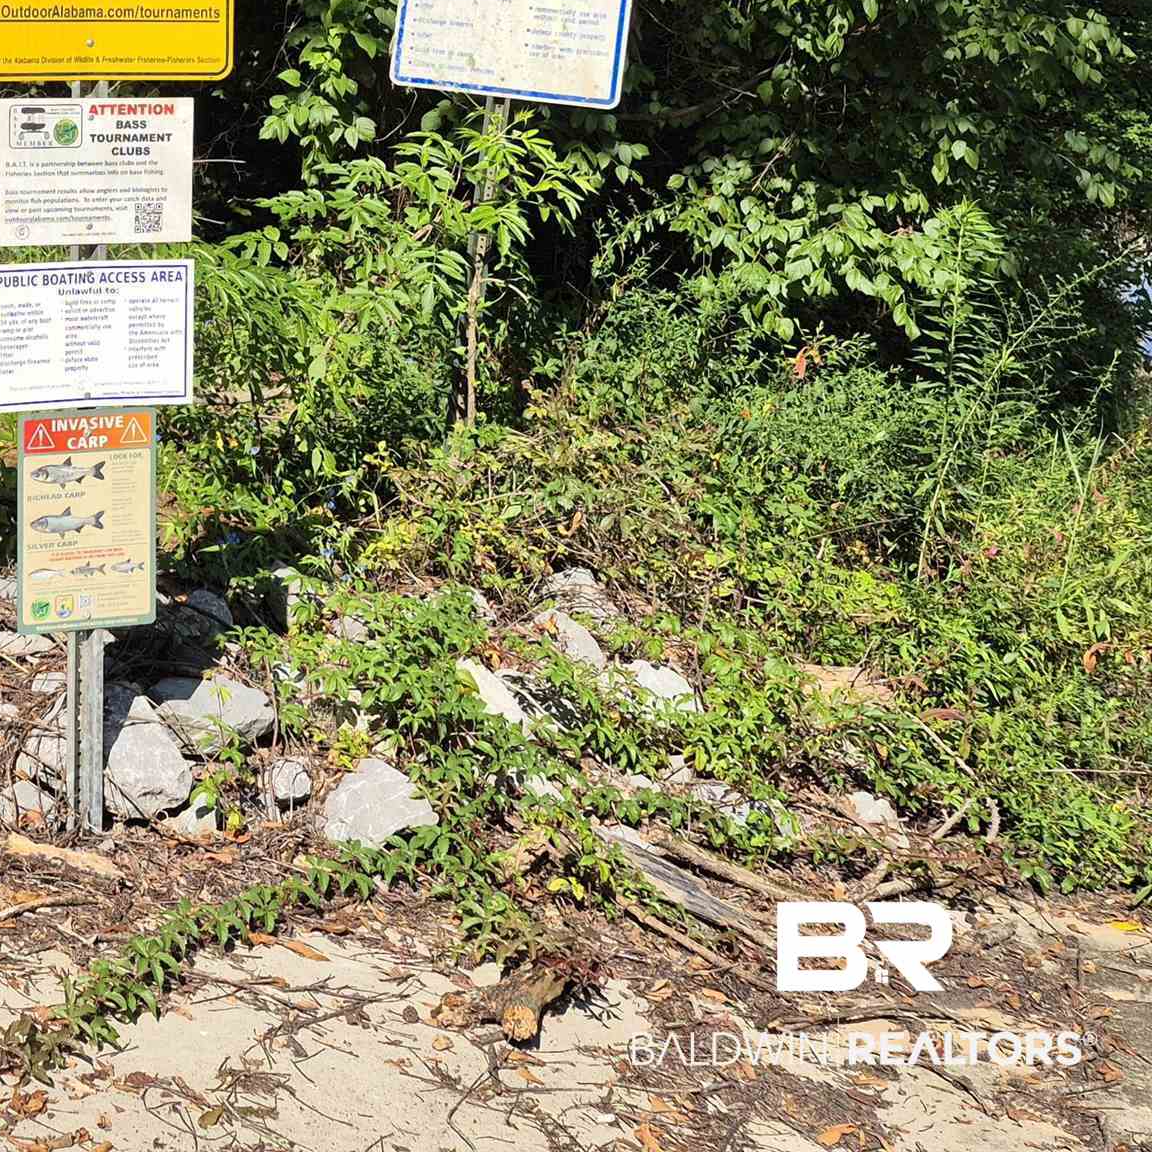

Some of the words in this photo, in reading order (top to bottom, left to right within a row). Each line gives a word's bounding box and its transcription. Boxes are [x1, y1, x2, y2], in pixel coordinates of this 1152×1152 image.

[89, 104, 175, 116] ATTENTION
[115, 120, 147, 129] BASS
[89, 133, 173, 143] TOURNAMENT
[111, 147, 151, 156] CLUBS
[43, 273, 95, 286] BOATING
[99, 272, 146, 284] ACCESS
[151, 270, 183, 282] AREA
[58, 288, 102, 296] Unlawful
[106, 287, 119, 295] to:
[51, 416, 124, 432] INVASIVE
[67, 435, 109, 450] CARP
